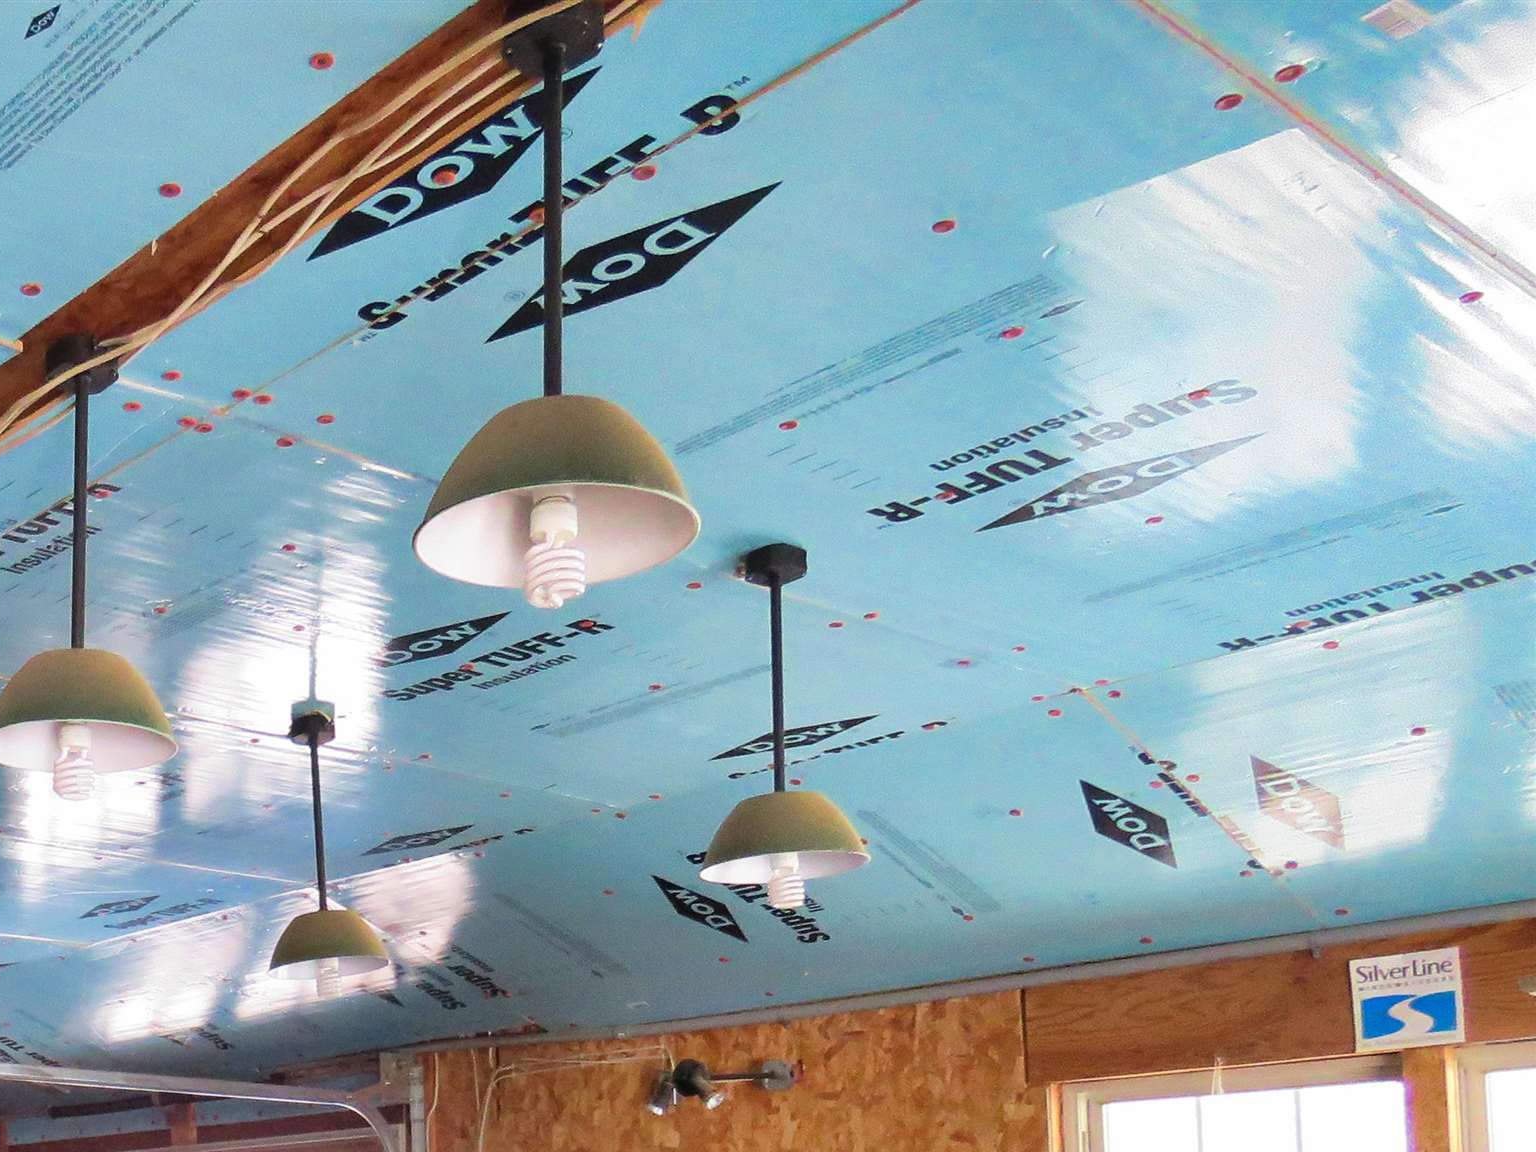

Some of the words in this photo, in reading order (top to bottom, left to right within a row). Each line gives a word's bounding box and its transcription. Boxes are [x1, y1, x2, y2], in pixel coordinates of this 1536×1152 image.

[353, 104, 543, 228] DOW
[531, 216, 718, 311] DOW
[929, 406, 1103, 472] Insulation
[1077, 377, 1259, 453] Super
[865, 447, 1076, 526] TUFF-R
[1030, 456, 1194, 517] DOW
[0, 525, 103, 575] Insulatin
[1284, 571, 1447, 618] Insulation
[1412, 560, 1536, 604] uper
[382, 661, 484, 702] Super
[470, 618, 617, 668] TUFF-R
[383, 623, 479, 664] DOW
[471, 652, 578, 691] Insulation
[740, 722, 843, 753] DOW
[1091, 797, 1168, 850] DOW
[1257, 776, 1336, 833] DOW
[667, 888, 735, 930] DOW
